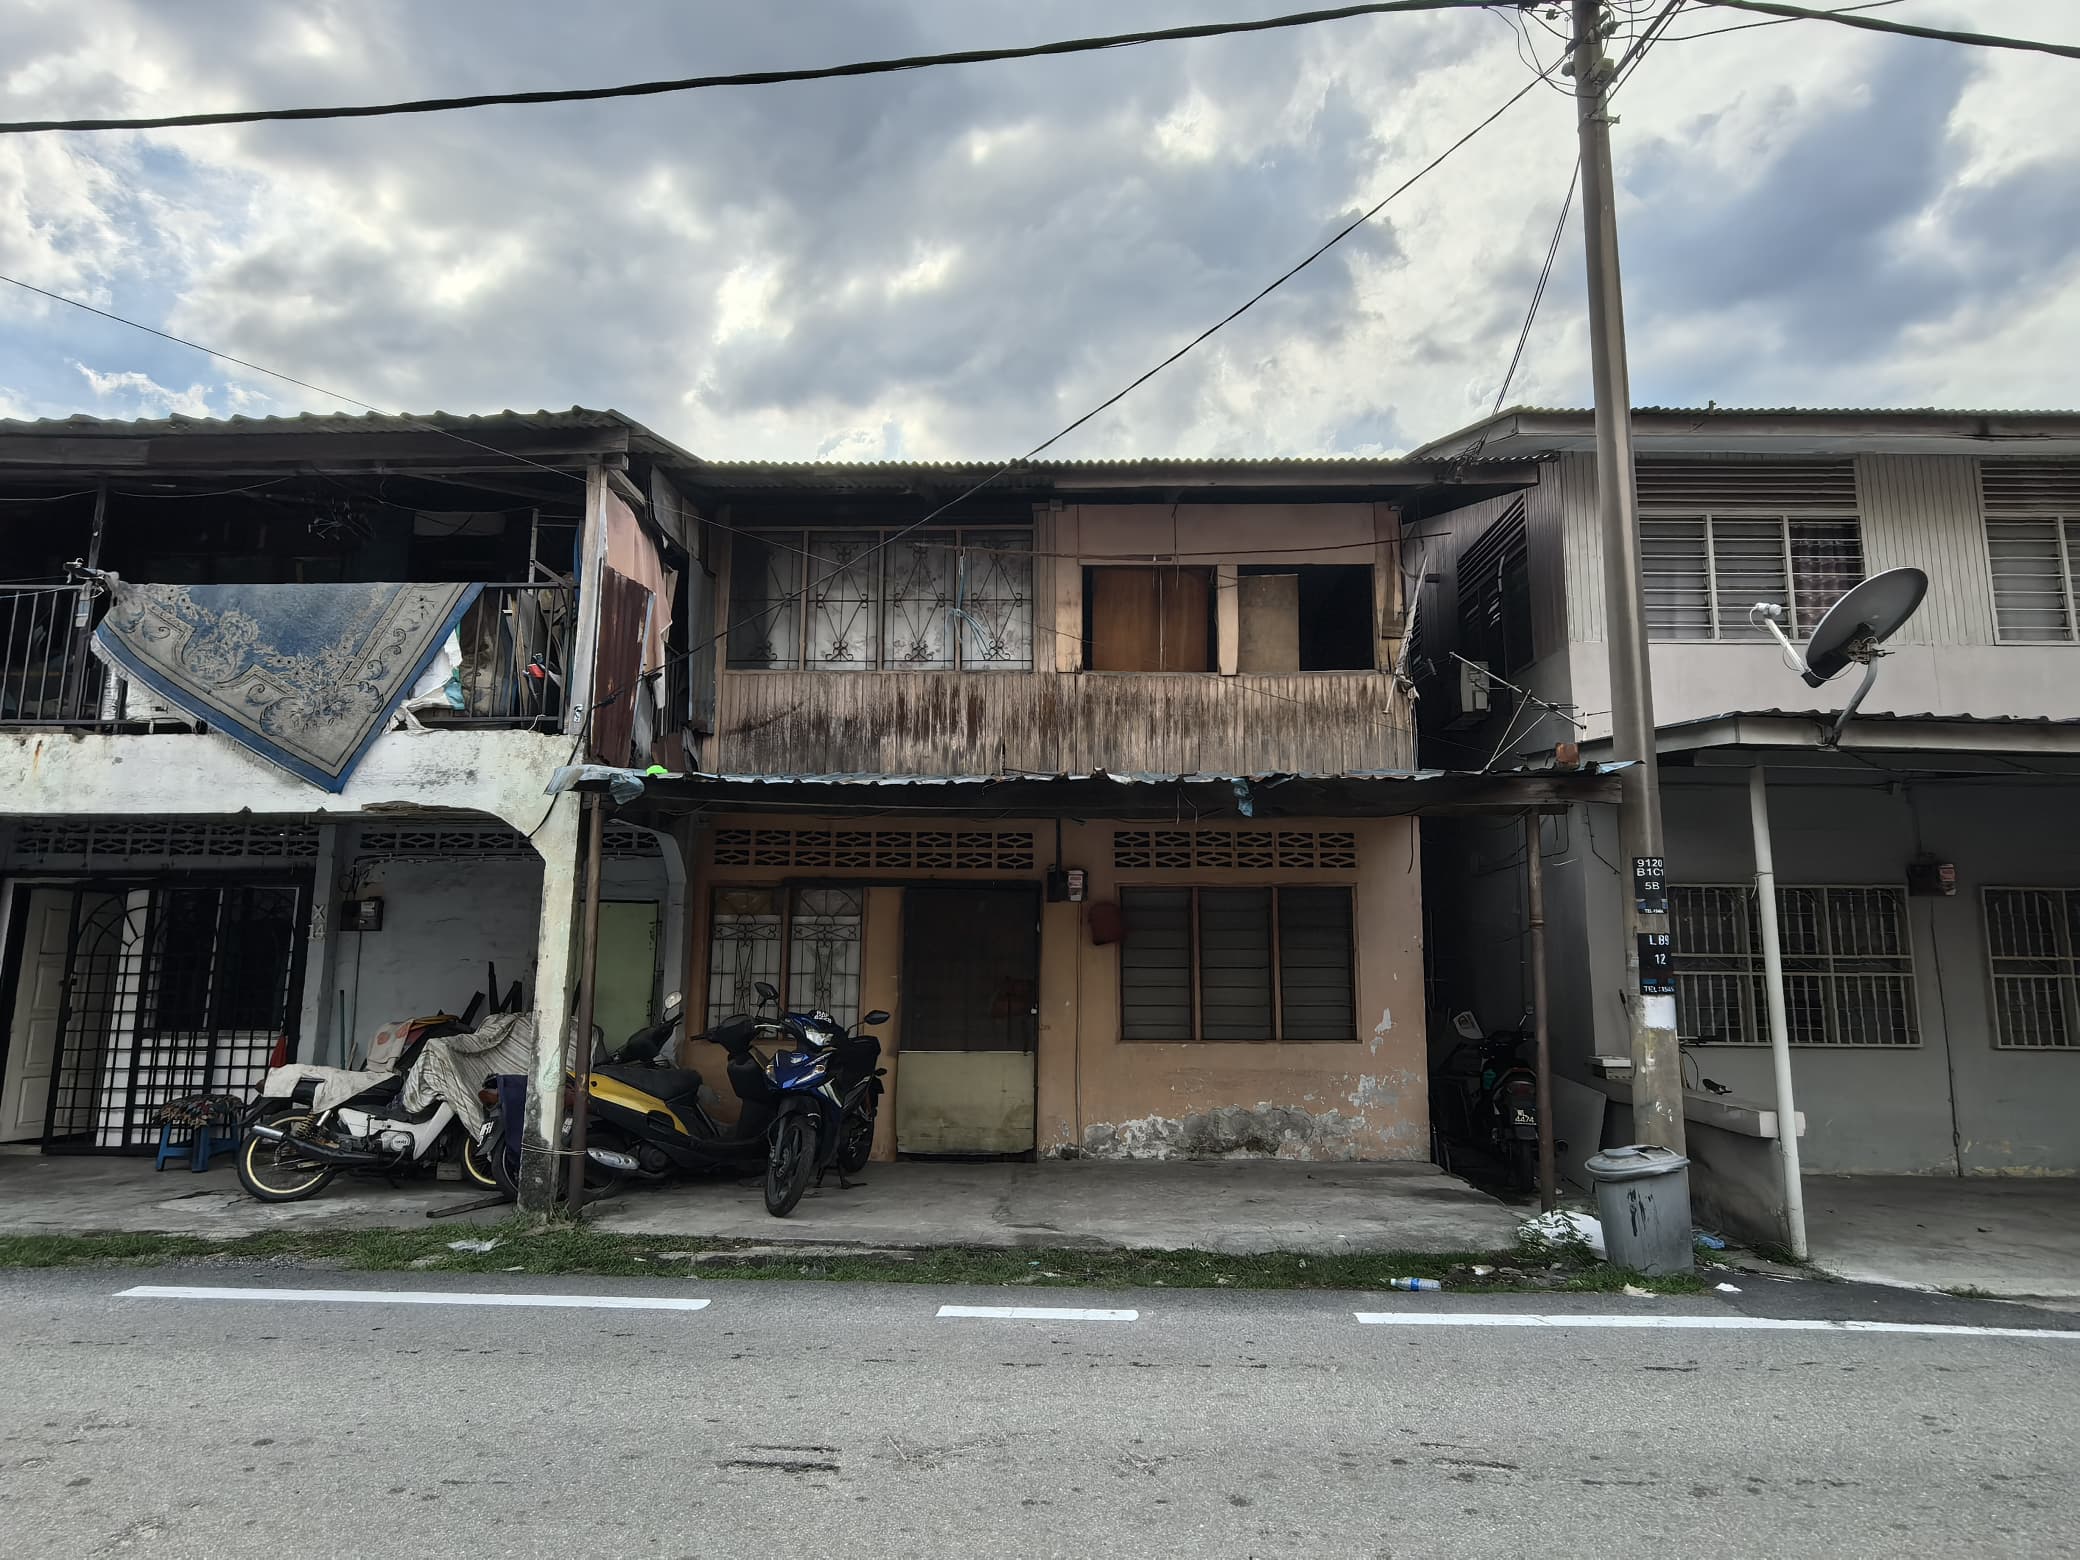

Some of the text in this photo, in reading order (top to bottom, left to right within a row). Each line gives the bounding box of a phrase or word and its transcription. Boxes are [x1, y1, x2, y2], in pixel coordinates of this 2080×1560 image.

[1637, 859, 1662, 867] 9120
[1645, 881, 1660, 889] 5B
[312, 904, 325, 920] X
[307, 924, 325, 939] 14
[1655, 954, 1667, 964] 12
